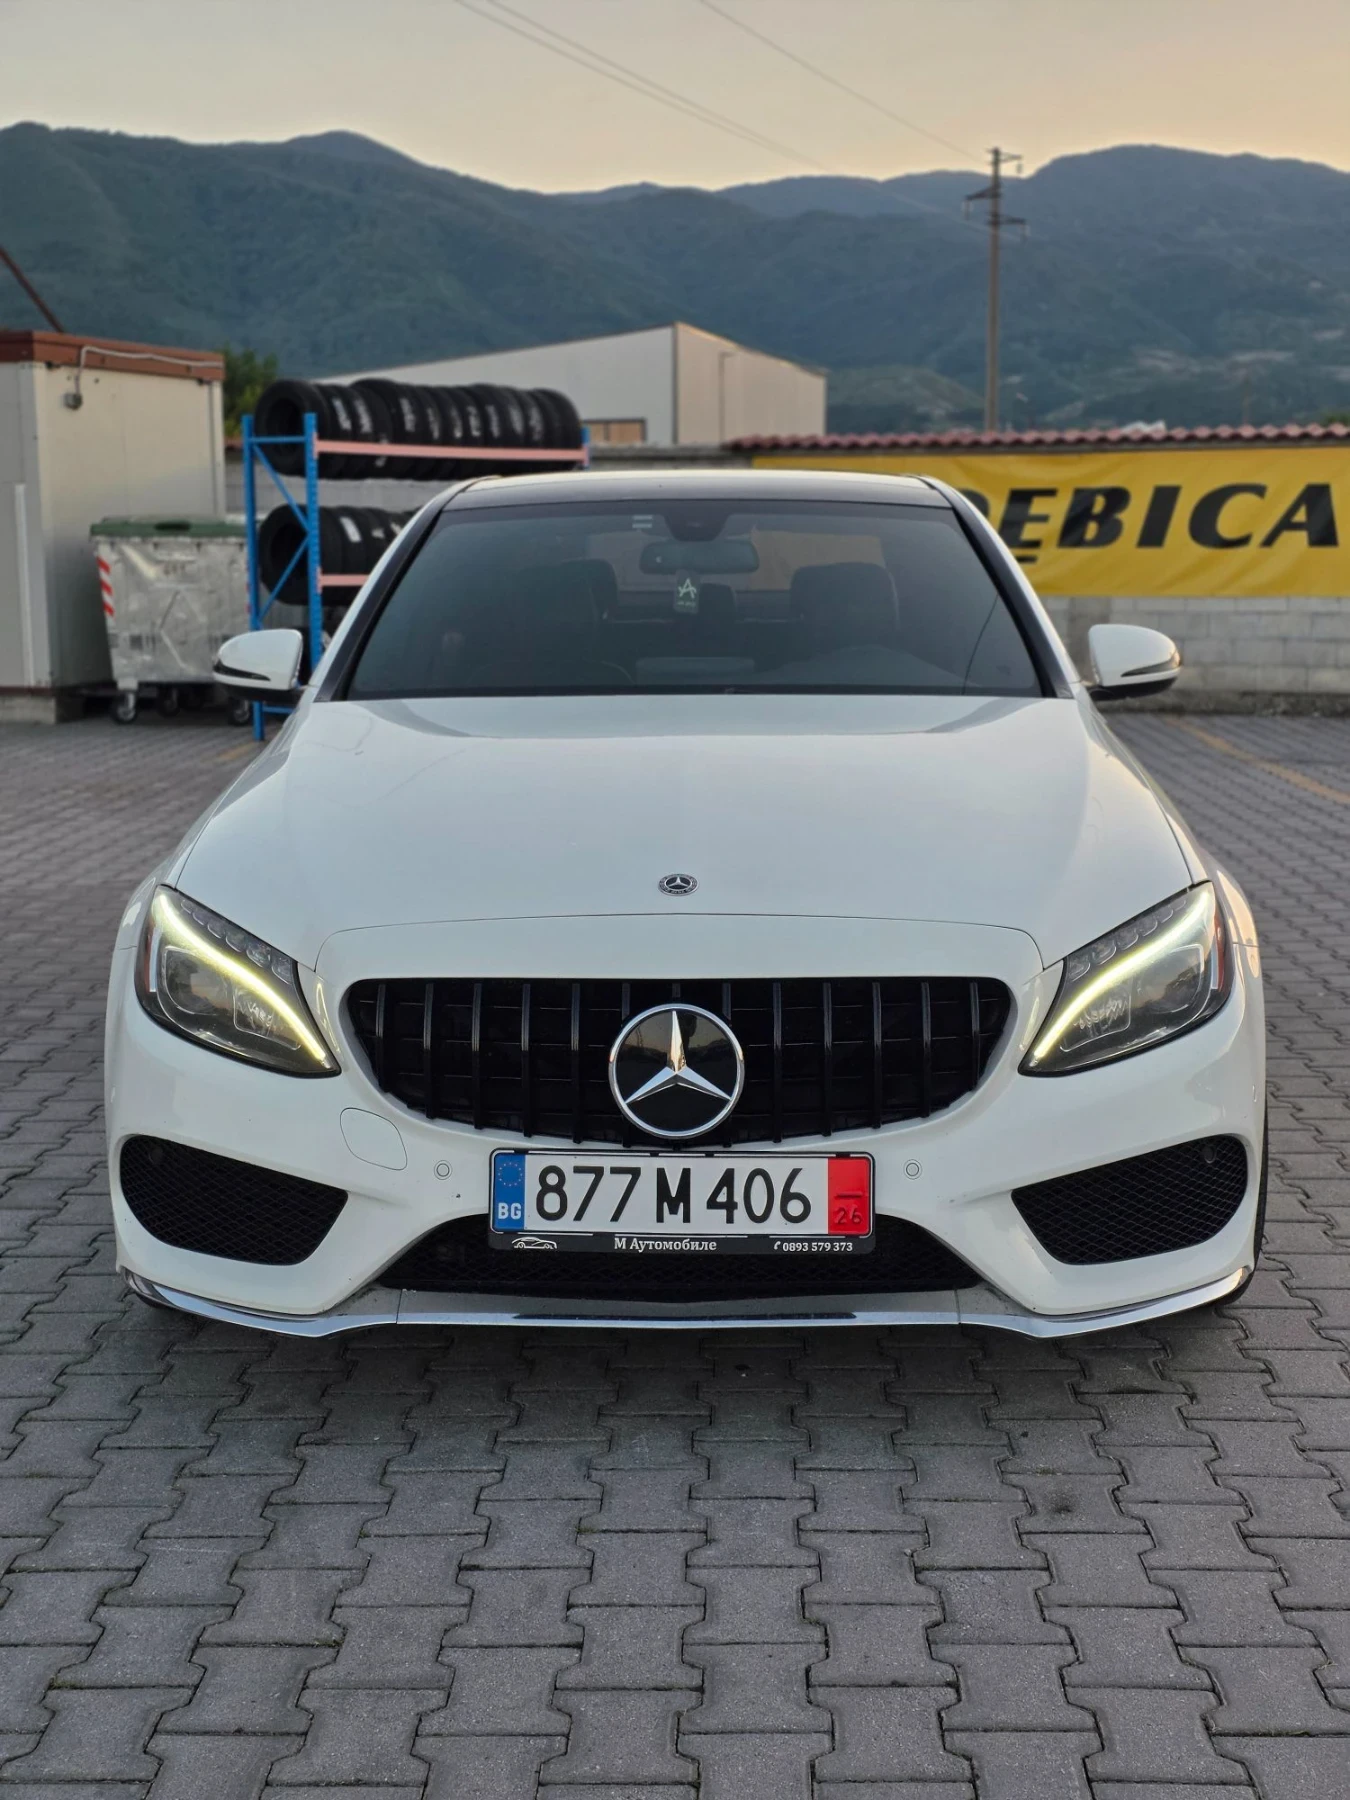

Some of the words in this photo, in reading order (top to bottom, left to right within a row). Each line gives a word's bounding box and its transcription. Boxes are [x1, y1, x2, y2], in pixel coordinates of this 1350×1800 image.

[536, 1165, 641, 1222] 877
[656, 1167, 691, 1223] M
[706, 1167, 812, 1224] 406
[498, 1203, 521, 1220] BG
[834, 1205, 862, 1225] 26
[630, 1238, 717, 1253] Аутомобиле
[783, 1242, 808, 1252] 0893
[811, 1242, 831, 1252] 579
[833, 1242, 853, 1252] 373
